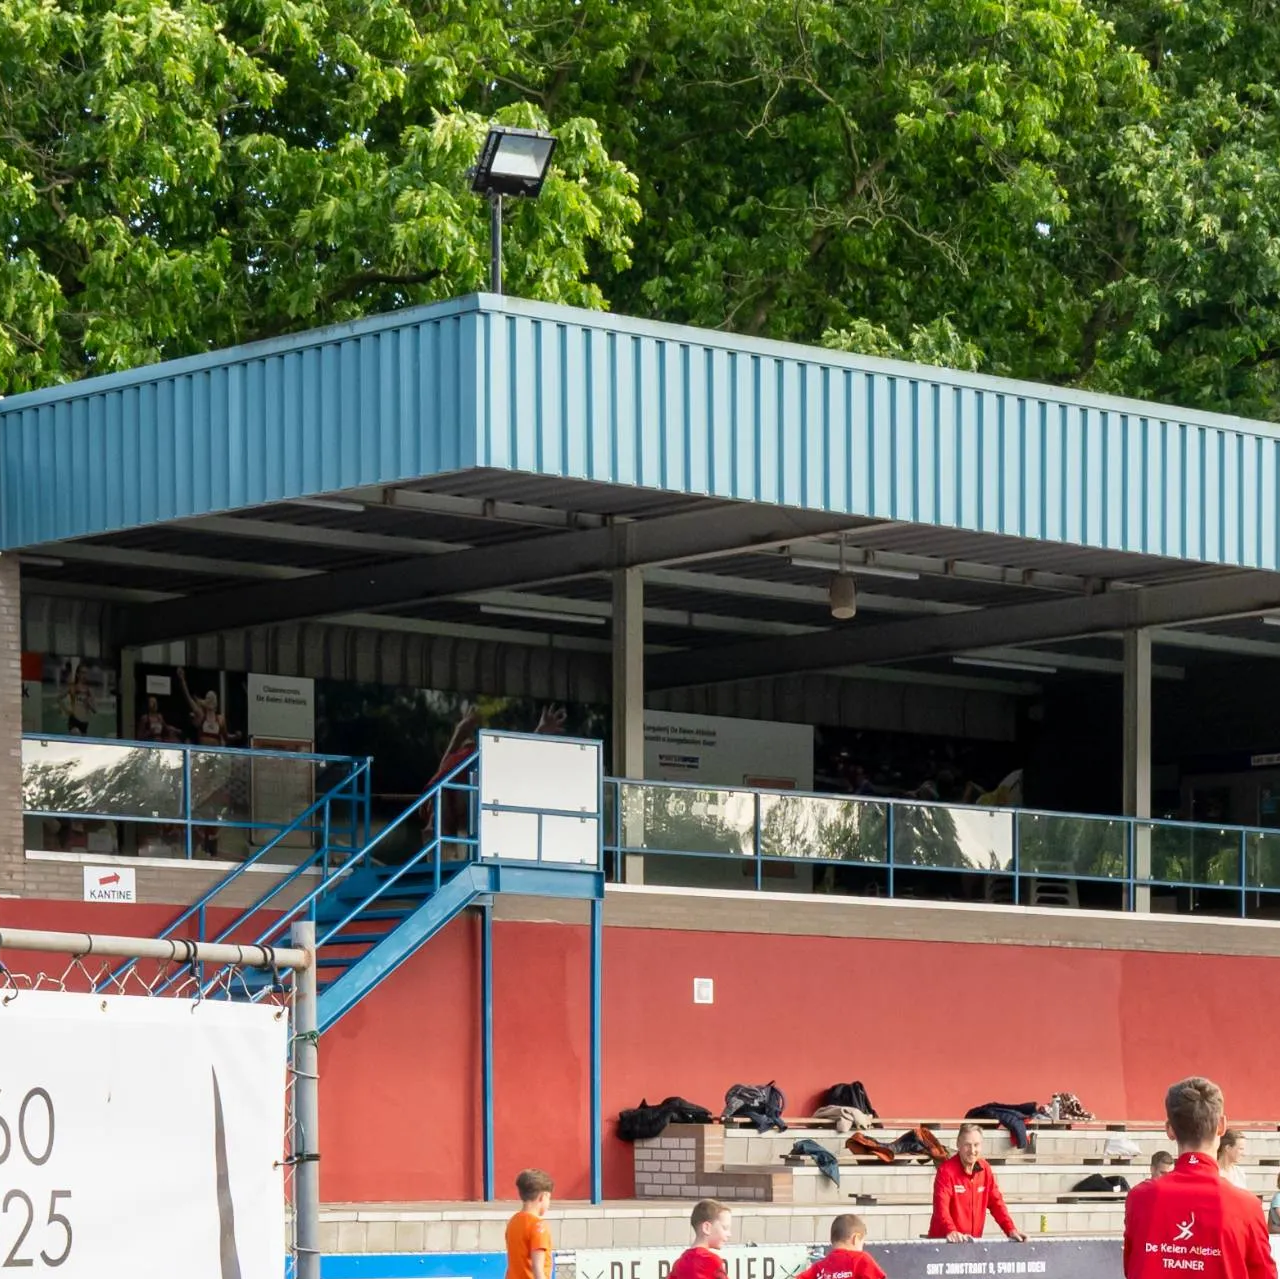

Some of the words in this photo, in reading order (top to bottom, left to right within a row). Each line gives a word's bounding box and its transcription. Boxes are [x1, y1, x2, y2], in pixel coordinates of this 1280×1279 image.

[89, 889, 133, 900] KANTINE
[1145, 1242, 1159, 1252] De
[1160, 1243, 1187, 1254] Keien
[1189, 1245, 1222, 1256] Atletiek
[1162, 1258, 1204, 1271] TRAINER
